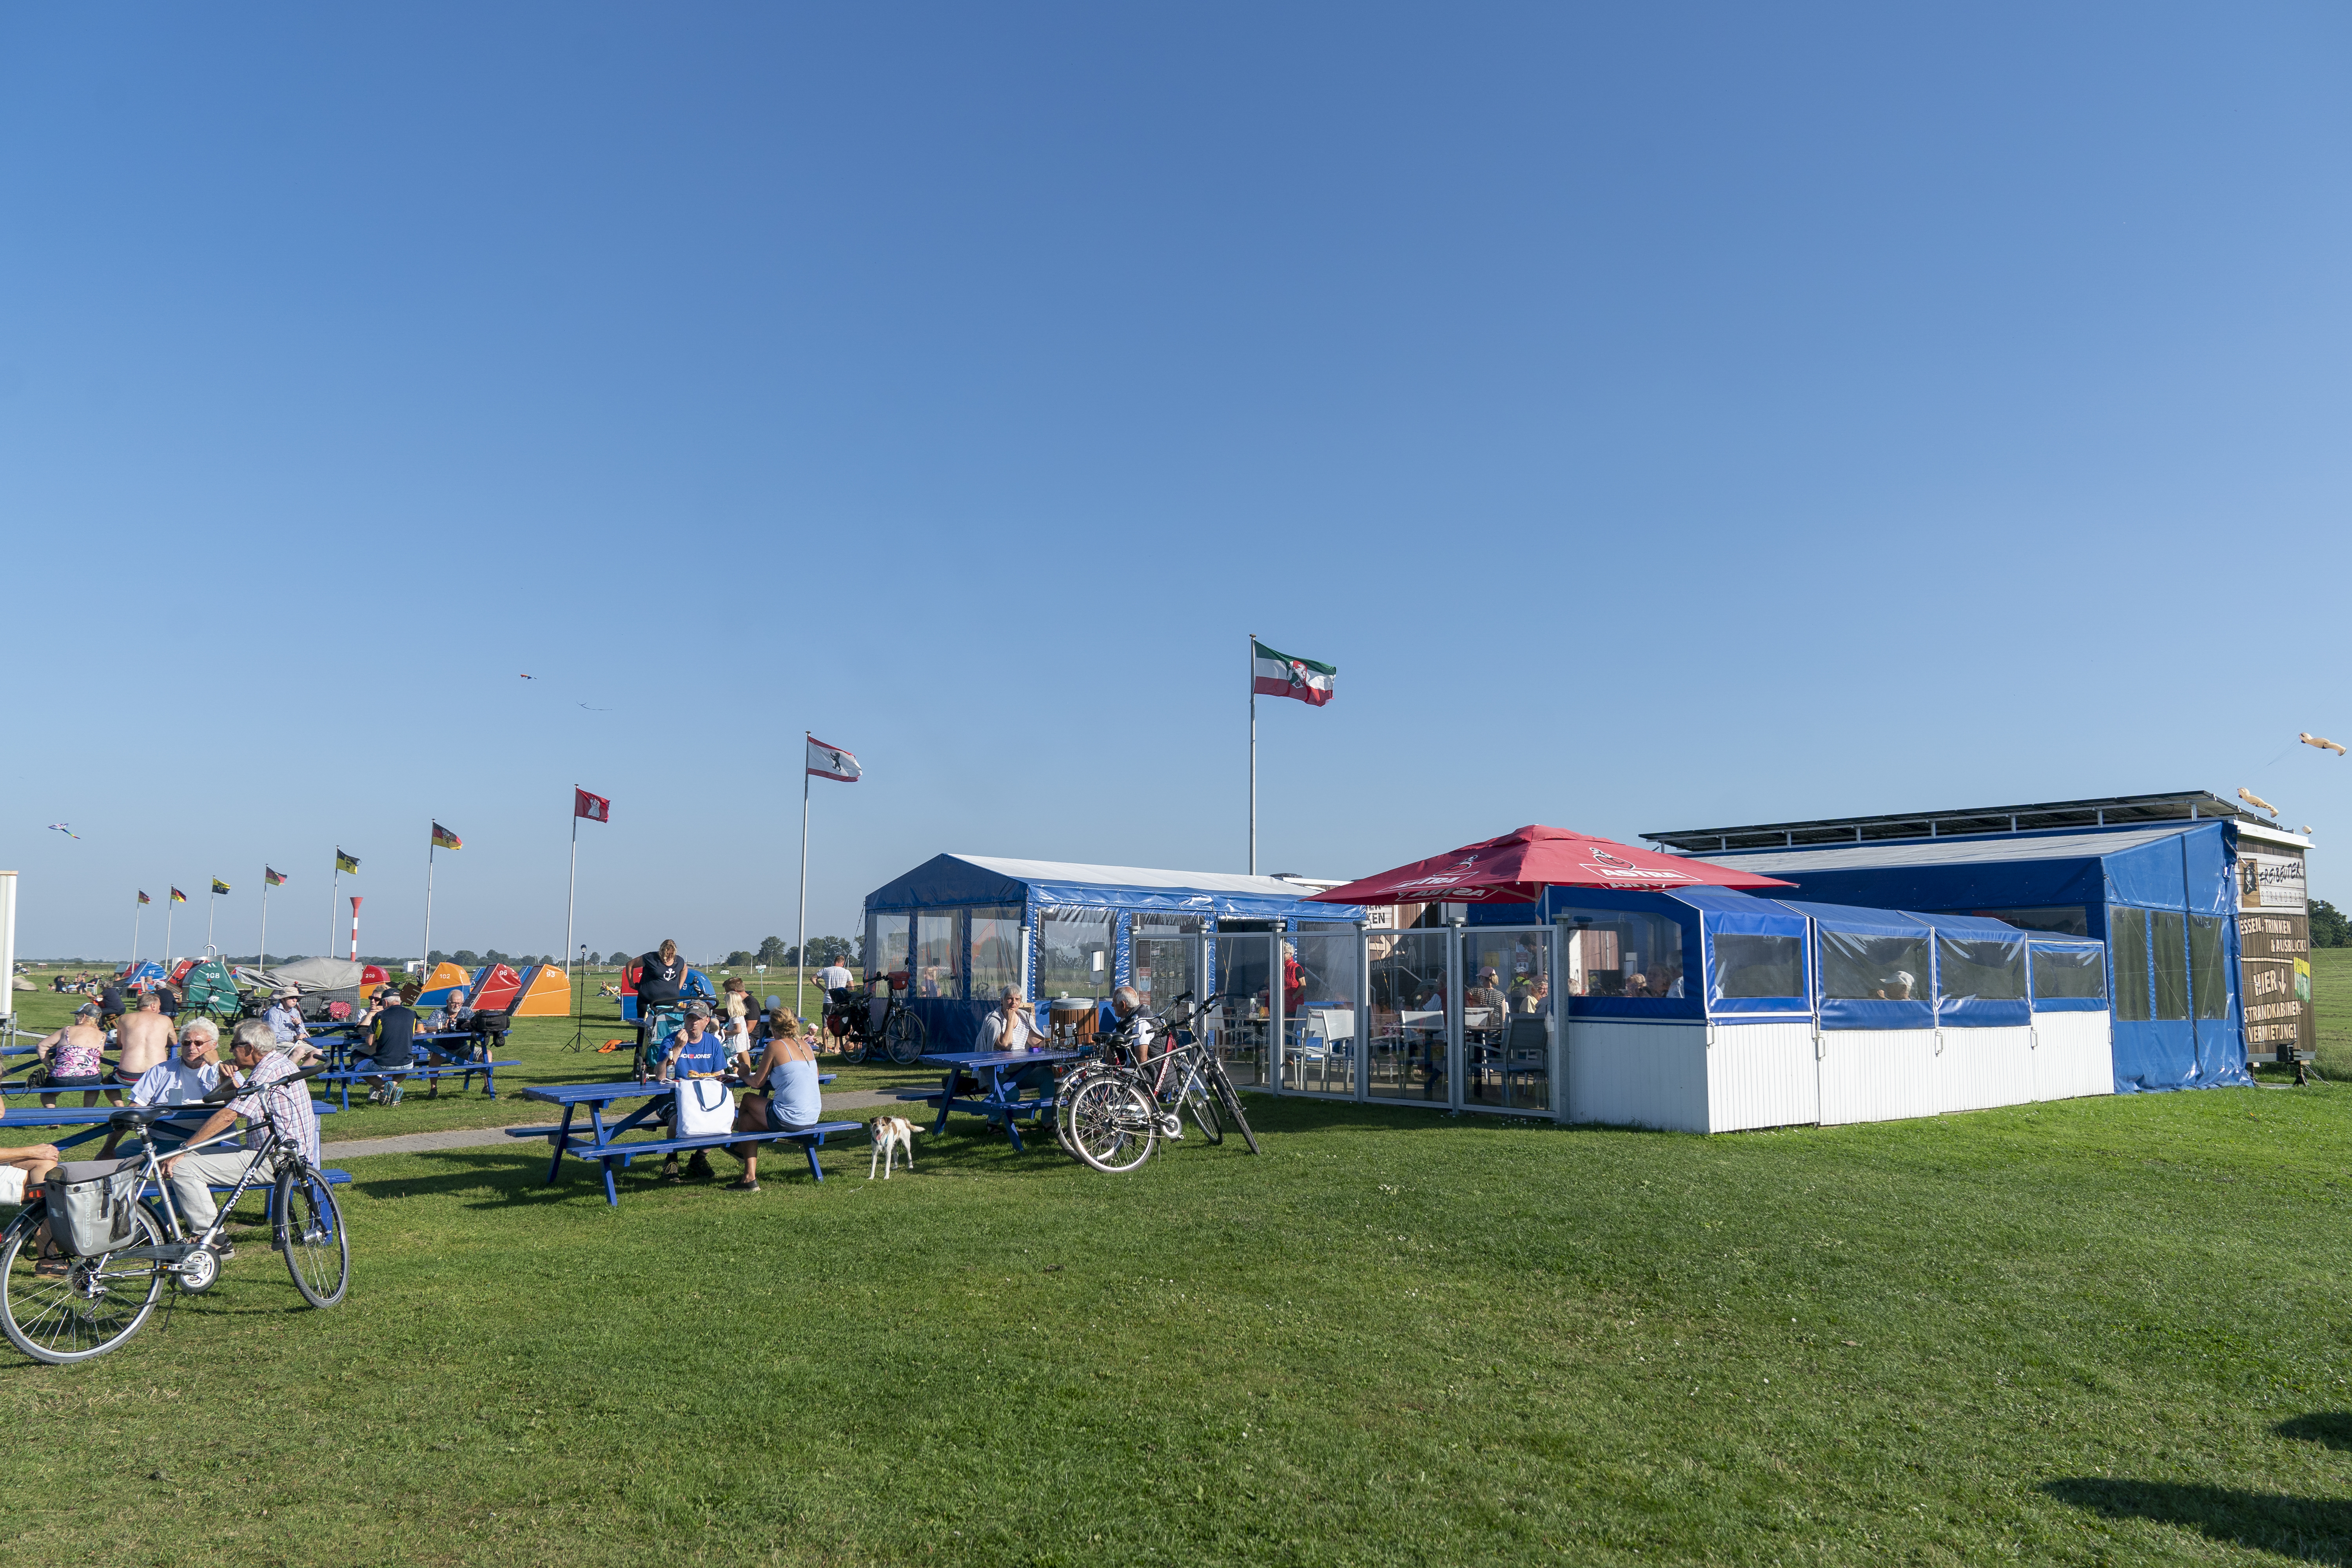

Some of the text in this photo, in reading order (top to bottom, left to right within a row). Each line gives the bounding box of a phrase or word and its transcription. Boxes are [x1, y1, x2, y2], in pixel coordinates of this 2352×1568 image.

[1600, 869, 1687, 878] ASTRA
[2239, 917, 2291, 935] ESSEN, TRINKEN
[2271, 939, 2307, 952] & AUSBLICK!
[2253, 970, 2278, 996] HIER
[2248, 1023, 2297, 1043] VERMIETUNG!
[1154, 1055, 1171, 1092] VICTORIA
[222, 1166, 257, 1212] Touring
